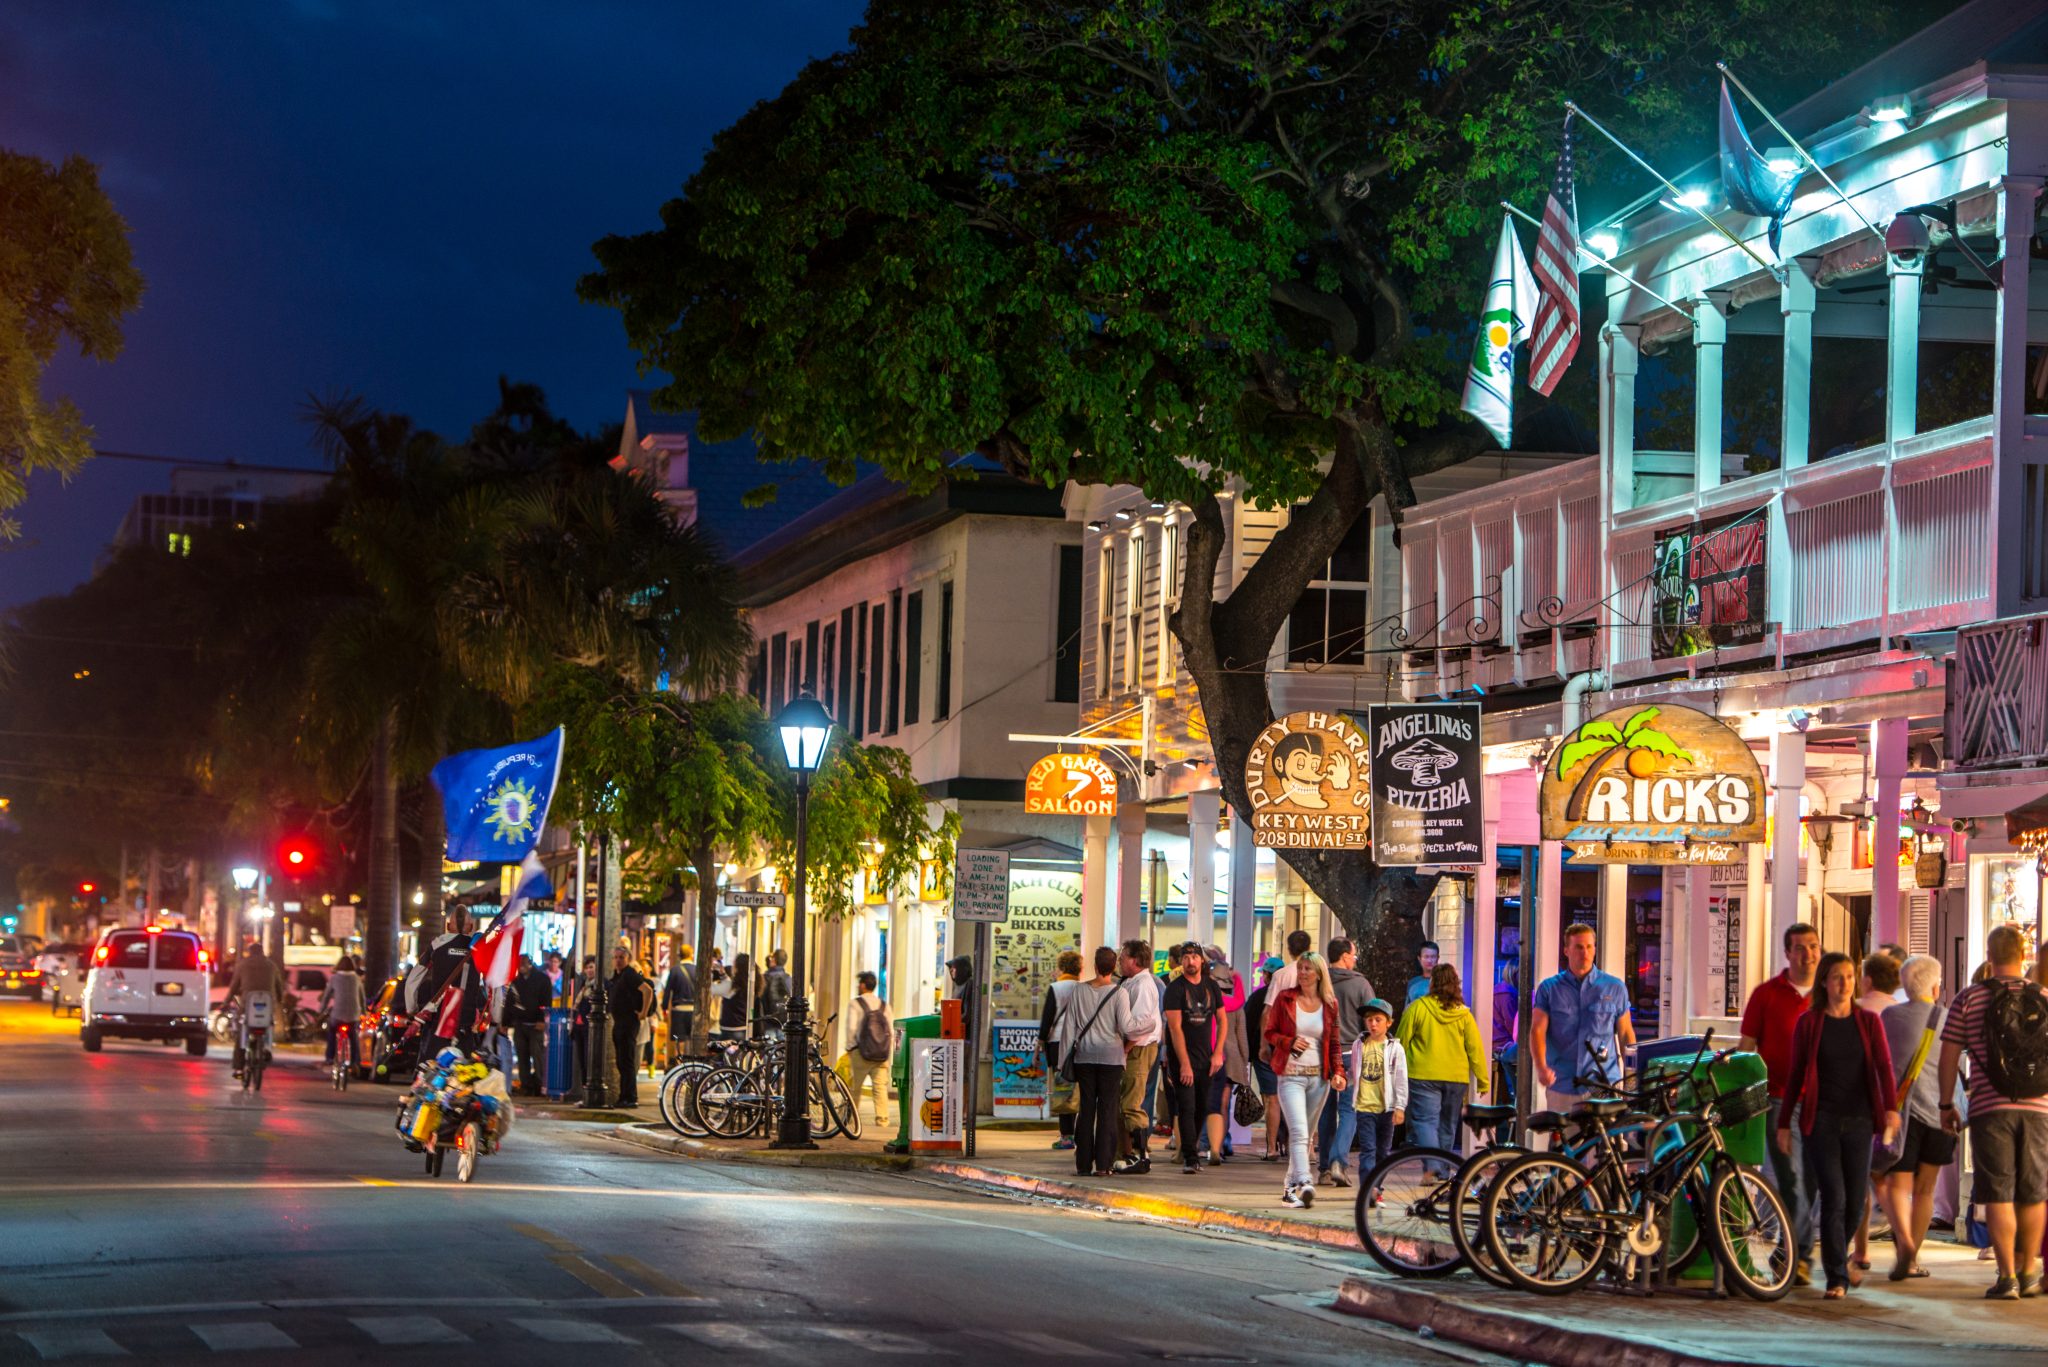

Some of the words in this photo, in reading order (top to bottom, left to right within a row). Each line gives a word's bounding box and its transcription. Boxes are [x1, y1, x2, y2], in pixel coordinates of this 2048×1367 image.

[1713, 575, 1749, 625] YEARS
[1375, 713, 1472, 758] ANGELINA'S
[1247, 717, 1292, 809] DURTY
[1028, 759, 1055, 792] RED
[1061, 755, 1116, 795] GARTER
[1386, 777, 1471, 812] PIZZERIA
[1587, 774, 1750, 824] RICK'S
[1029, 798, 1112, 814] SALOON
[1259, 814, 1299, 828] KEY
[1302, 815, 1363, 830] WEST
[1258, 831, 1287, 846] 208
[1289, 832, 1345, 847] DUVAL
[967, 855, 1000, 863] LOADING
[1604, 849, 1639, 859] DRINK
[1689, 845, 1705, 862] Key
[1706, 843, 1734, 862] West
[972, 864, 993, 872] ZONE
[981, 883, 1006, 891] STAND
[734, 895, 763, 904] Charles
[767, 895, 776, 904] St
[972, 901, 1004, 910] PARKING
[1011, 921, 1065, 931] BIKERS
[924, 1045, 944, 1102] CITIZEN
[930, 1108, 944, 1136] THE
